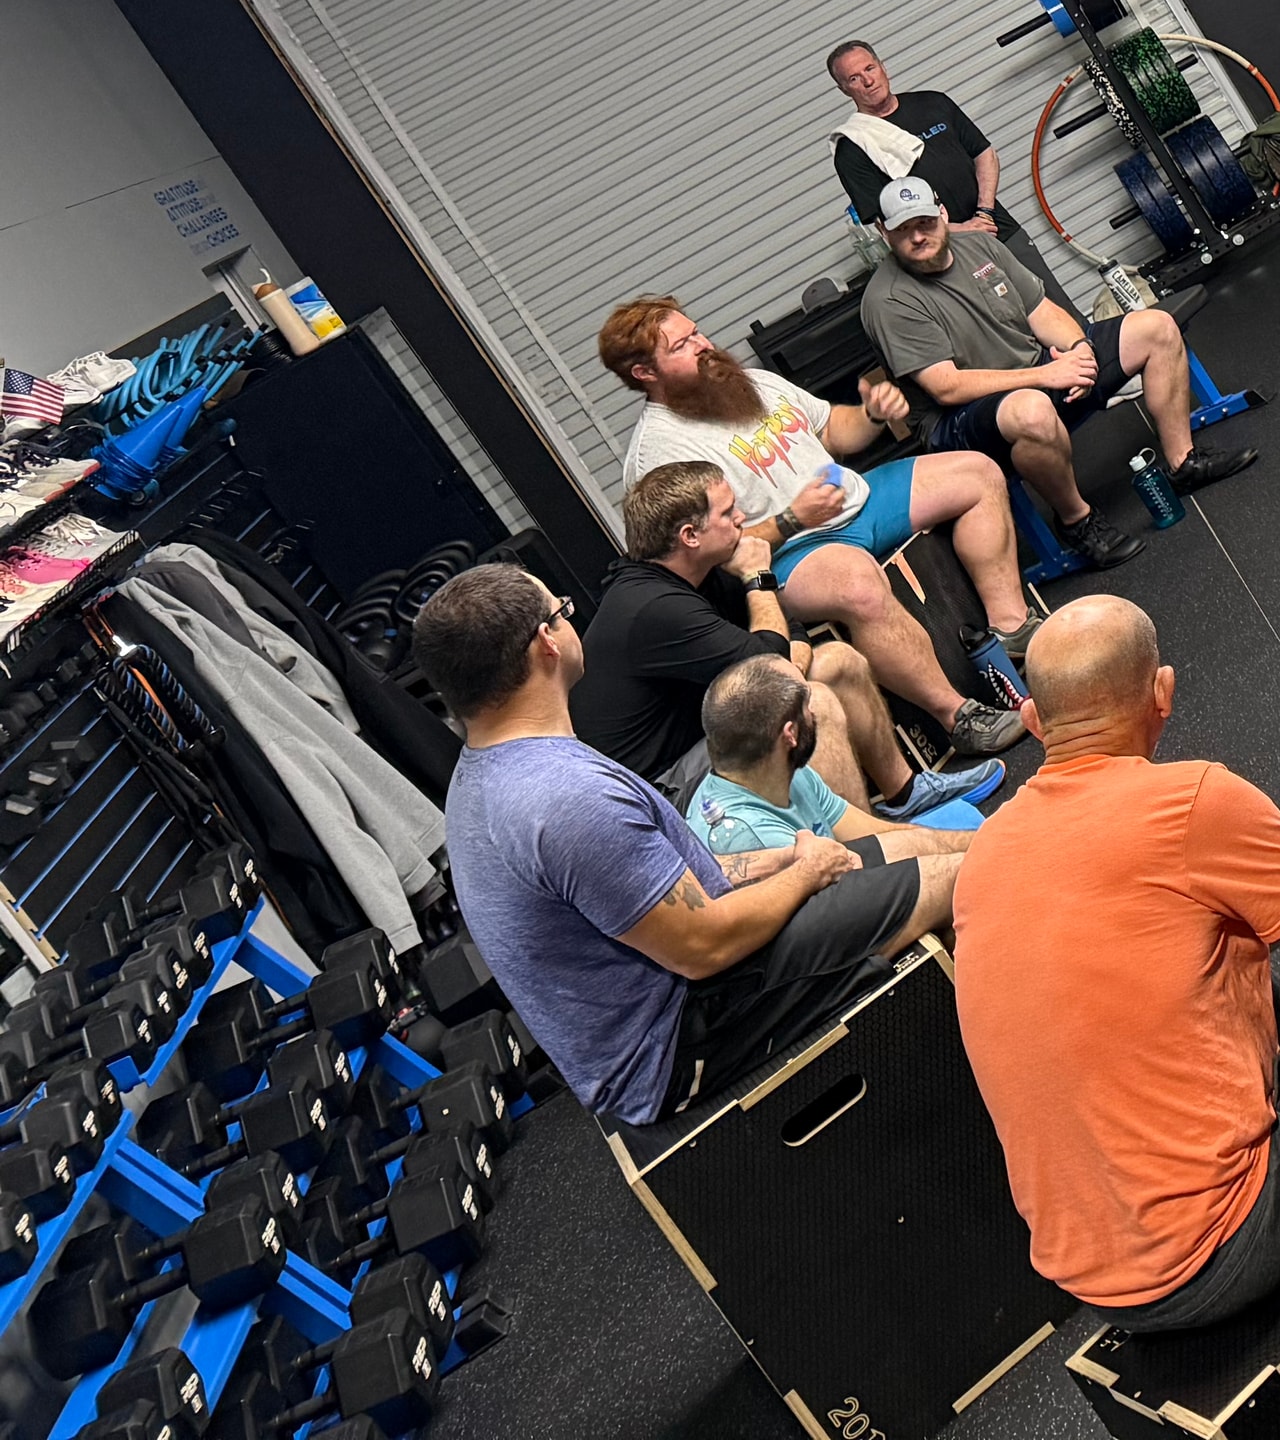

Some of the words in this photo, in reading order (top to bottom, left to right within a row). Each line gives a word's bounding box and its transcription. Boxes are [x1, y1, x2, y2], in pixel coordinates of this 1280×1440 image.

[154, 179, 199, 205] GRATITUDE
[166, 197, 203, 222] ATTITUDE
[177, 207, 228, 237] CHALLENGES
[207, 223, 240, 247] CHOICES
[827, 1396, 870, 1440] 20
